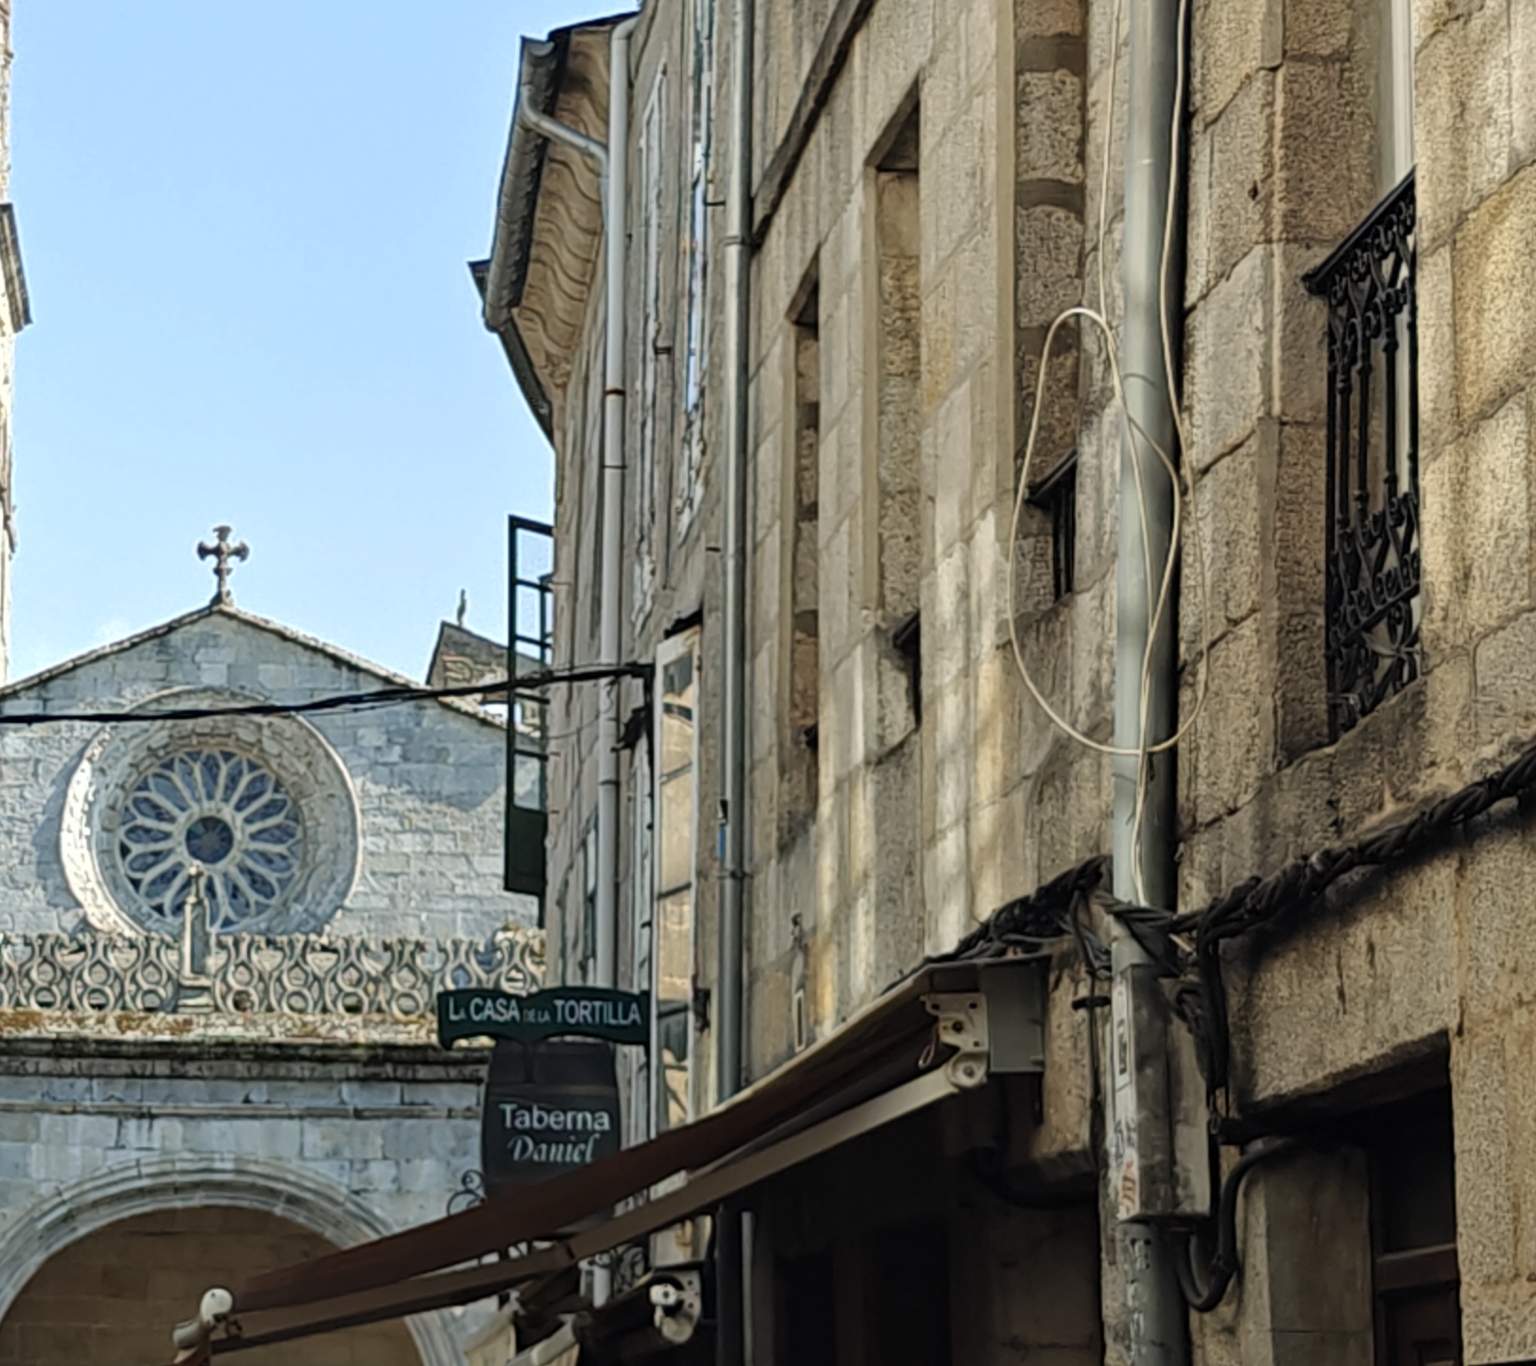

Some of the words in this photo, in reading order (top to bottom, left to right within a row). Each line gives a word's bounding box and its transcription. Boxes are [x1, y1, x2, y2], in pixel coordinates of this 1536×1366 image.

[469, 997, 520, 1022] CASA
[553, 999, 642, 1025] TORTILLA
[498, 1103, 611, 1131] Taberna
[506, 1133, 601, 1164] Daniel
